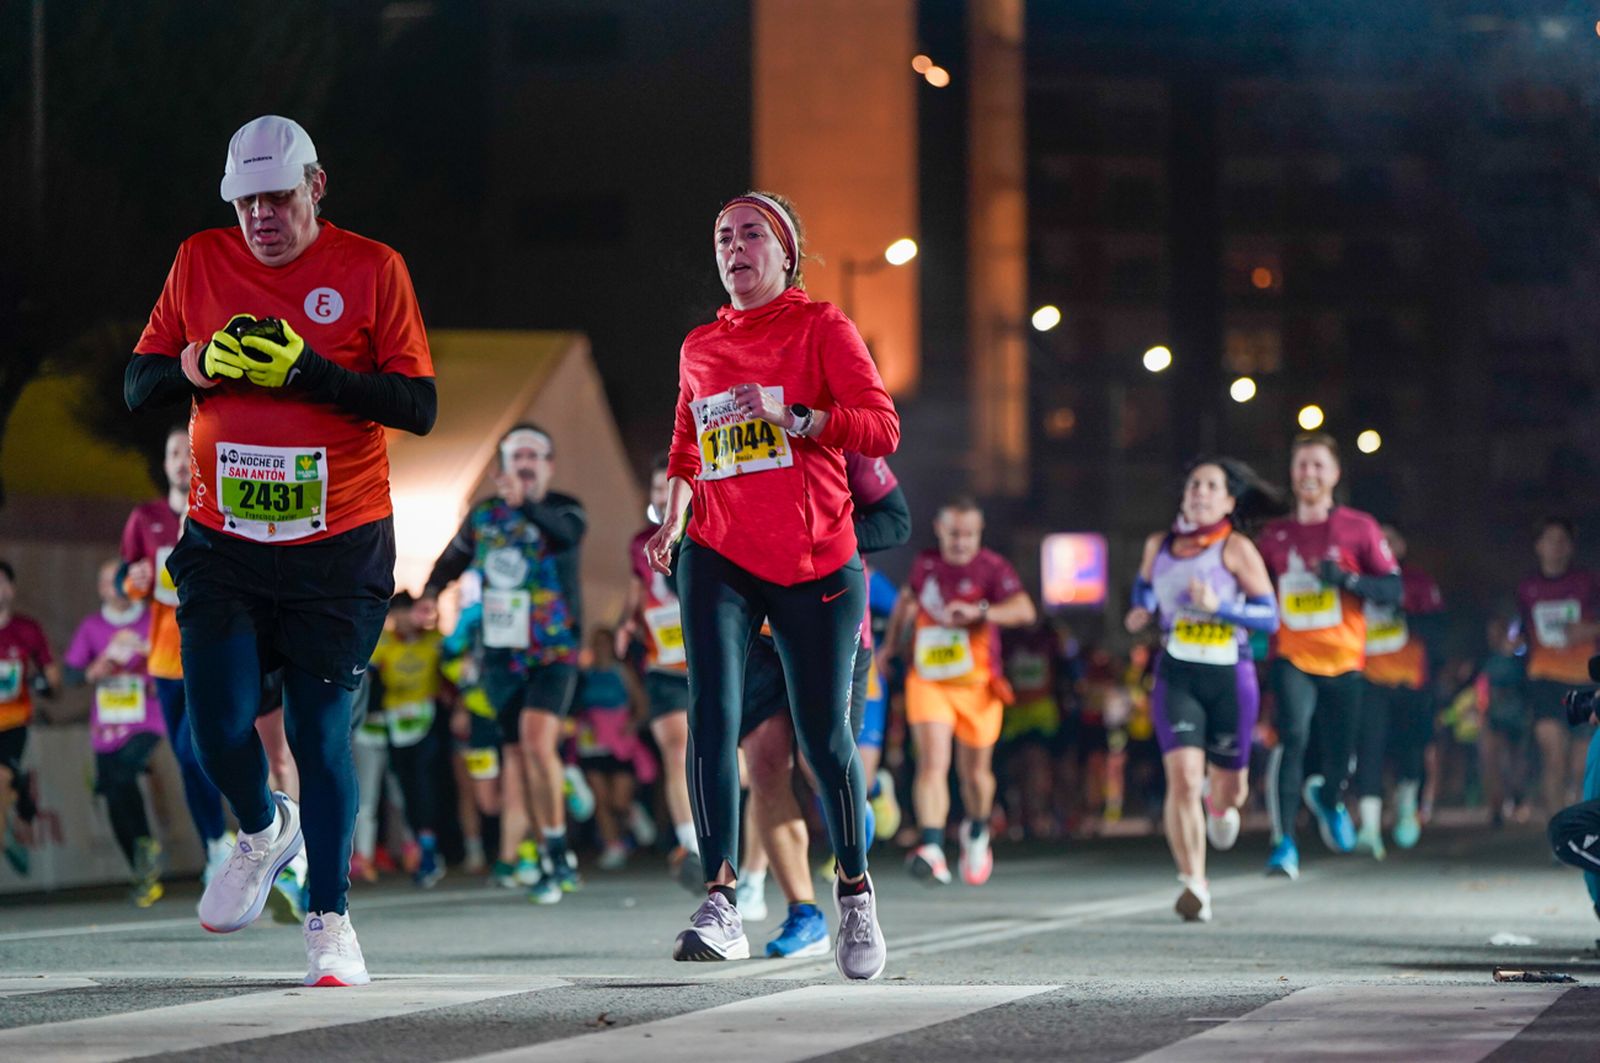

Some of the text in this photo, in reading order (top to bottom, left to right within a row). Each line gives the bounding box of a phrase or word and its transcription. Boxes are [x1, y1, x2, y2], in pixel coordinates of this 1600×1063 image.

[708, 421, 776, 460] 13044
[228, 466, 248, 478] SAN
[250, 468, 285, 481] ANTÓN
[240, 456, 272, 469] NOCHE
[273, 458, 285, 469] DE
[239, 481, 304, 512] 2431
